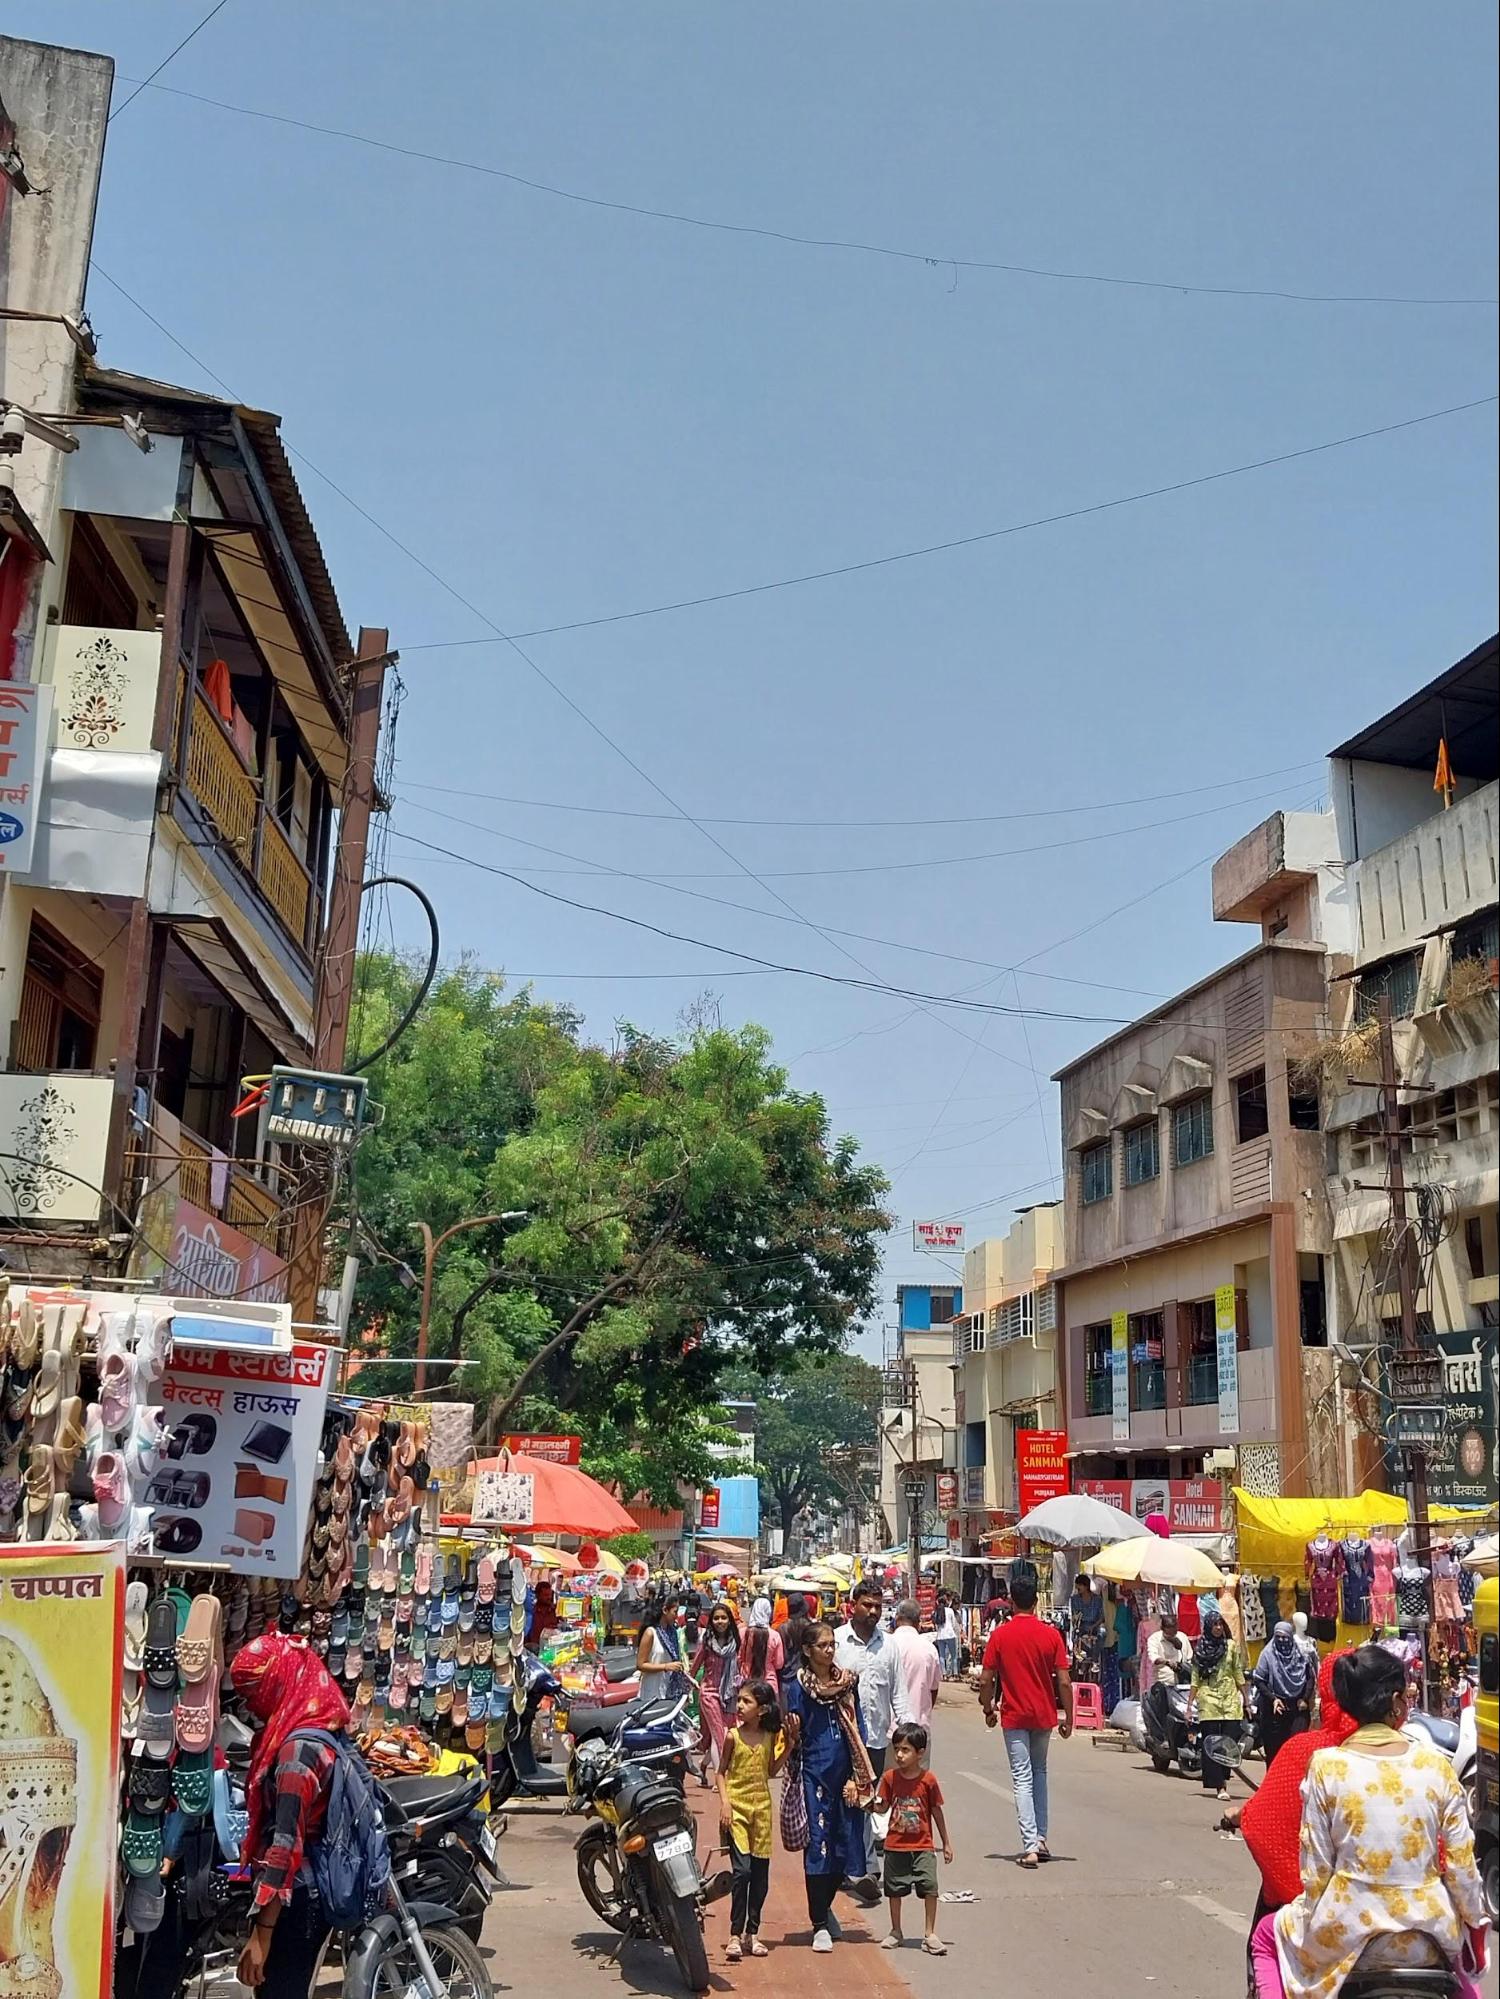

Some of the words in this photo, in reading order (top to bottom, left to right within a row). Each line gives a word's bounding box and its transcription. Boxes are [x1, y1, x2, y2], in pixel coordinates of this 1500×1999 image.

[233, 1391, 300, 1416] हाऊस
[1029, 1443, 1056, 1454] HOTEL
[1023, 1456, 1064, 1468] SANMAN
[1185, 1482, 1204, 1498] Hotel
[1173, 1503, 1215, 1527] SANMAN
[10, 1574, 104, 1600] चप्पल
